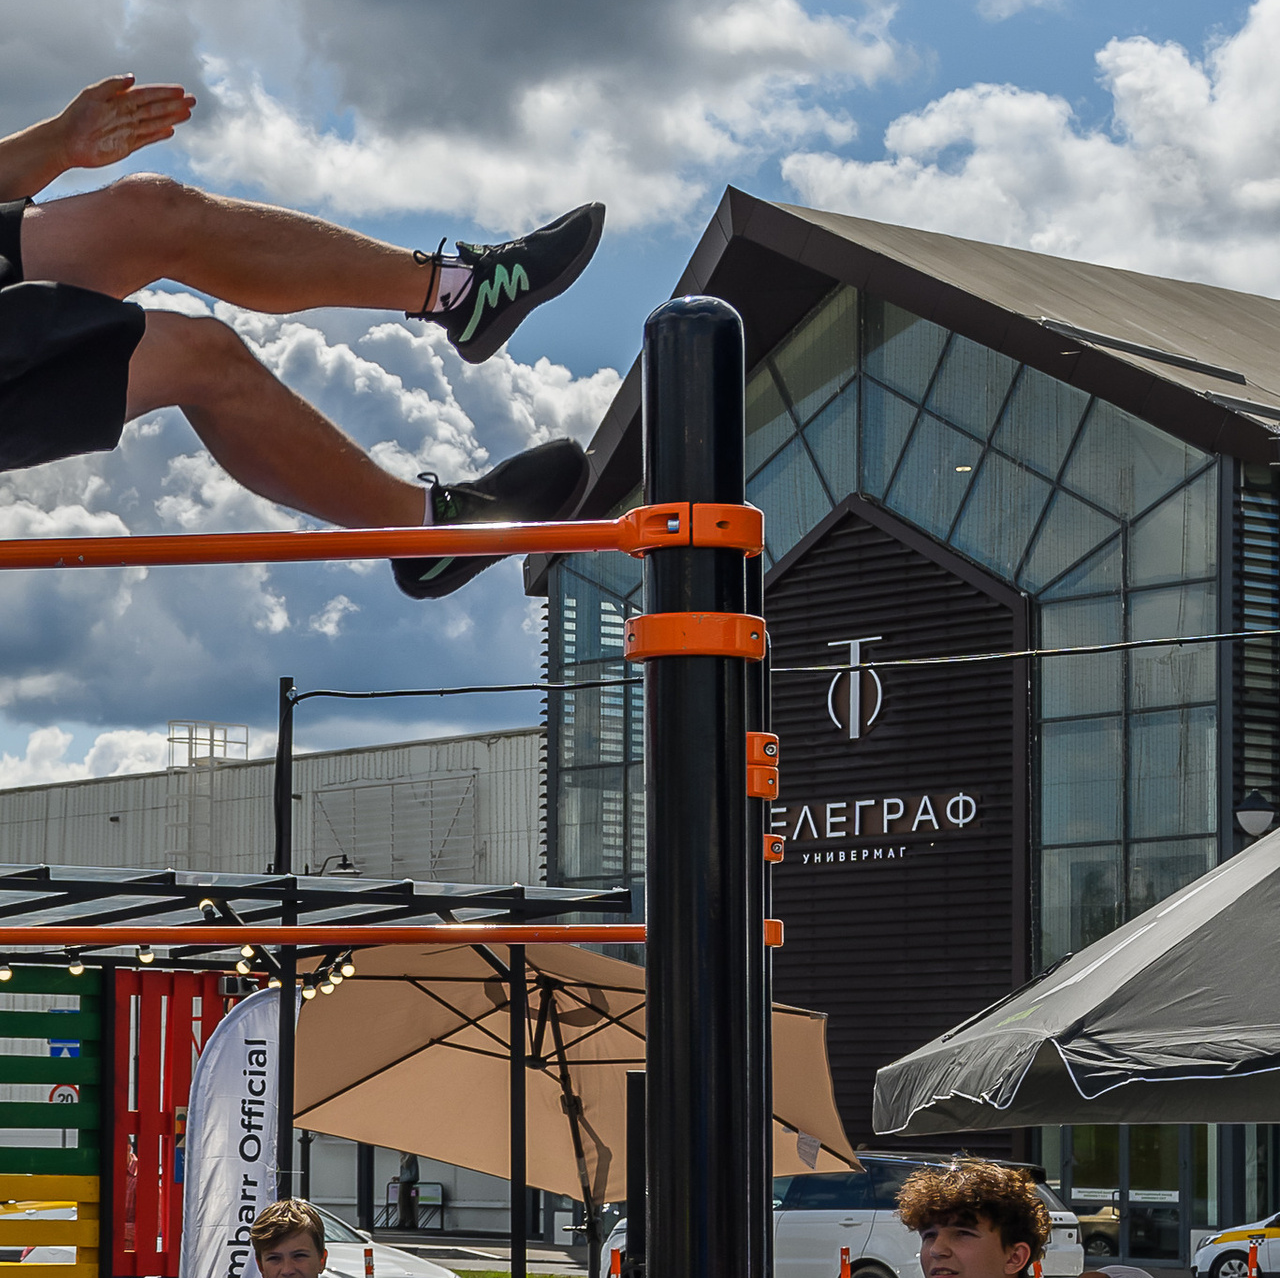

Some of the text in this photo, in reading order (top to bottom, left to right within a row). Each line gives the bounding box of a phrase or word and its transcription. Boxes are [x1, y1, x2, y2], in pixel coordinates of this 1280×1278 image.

[770, 792, 977, 841] ЕЛЕГРАФ
[802, 846, 907, 864] УНИВЕРМАГ
[238, 1038, 267, 1163] Official
